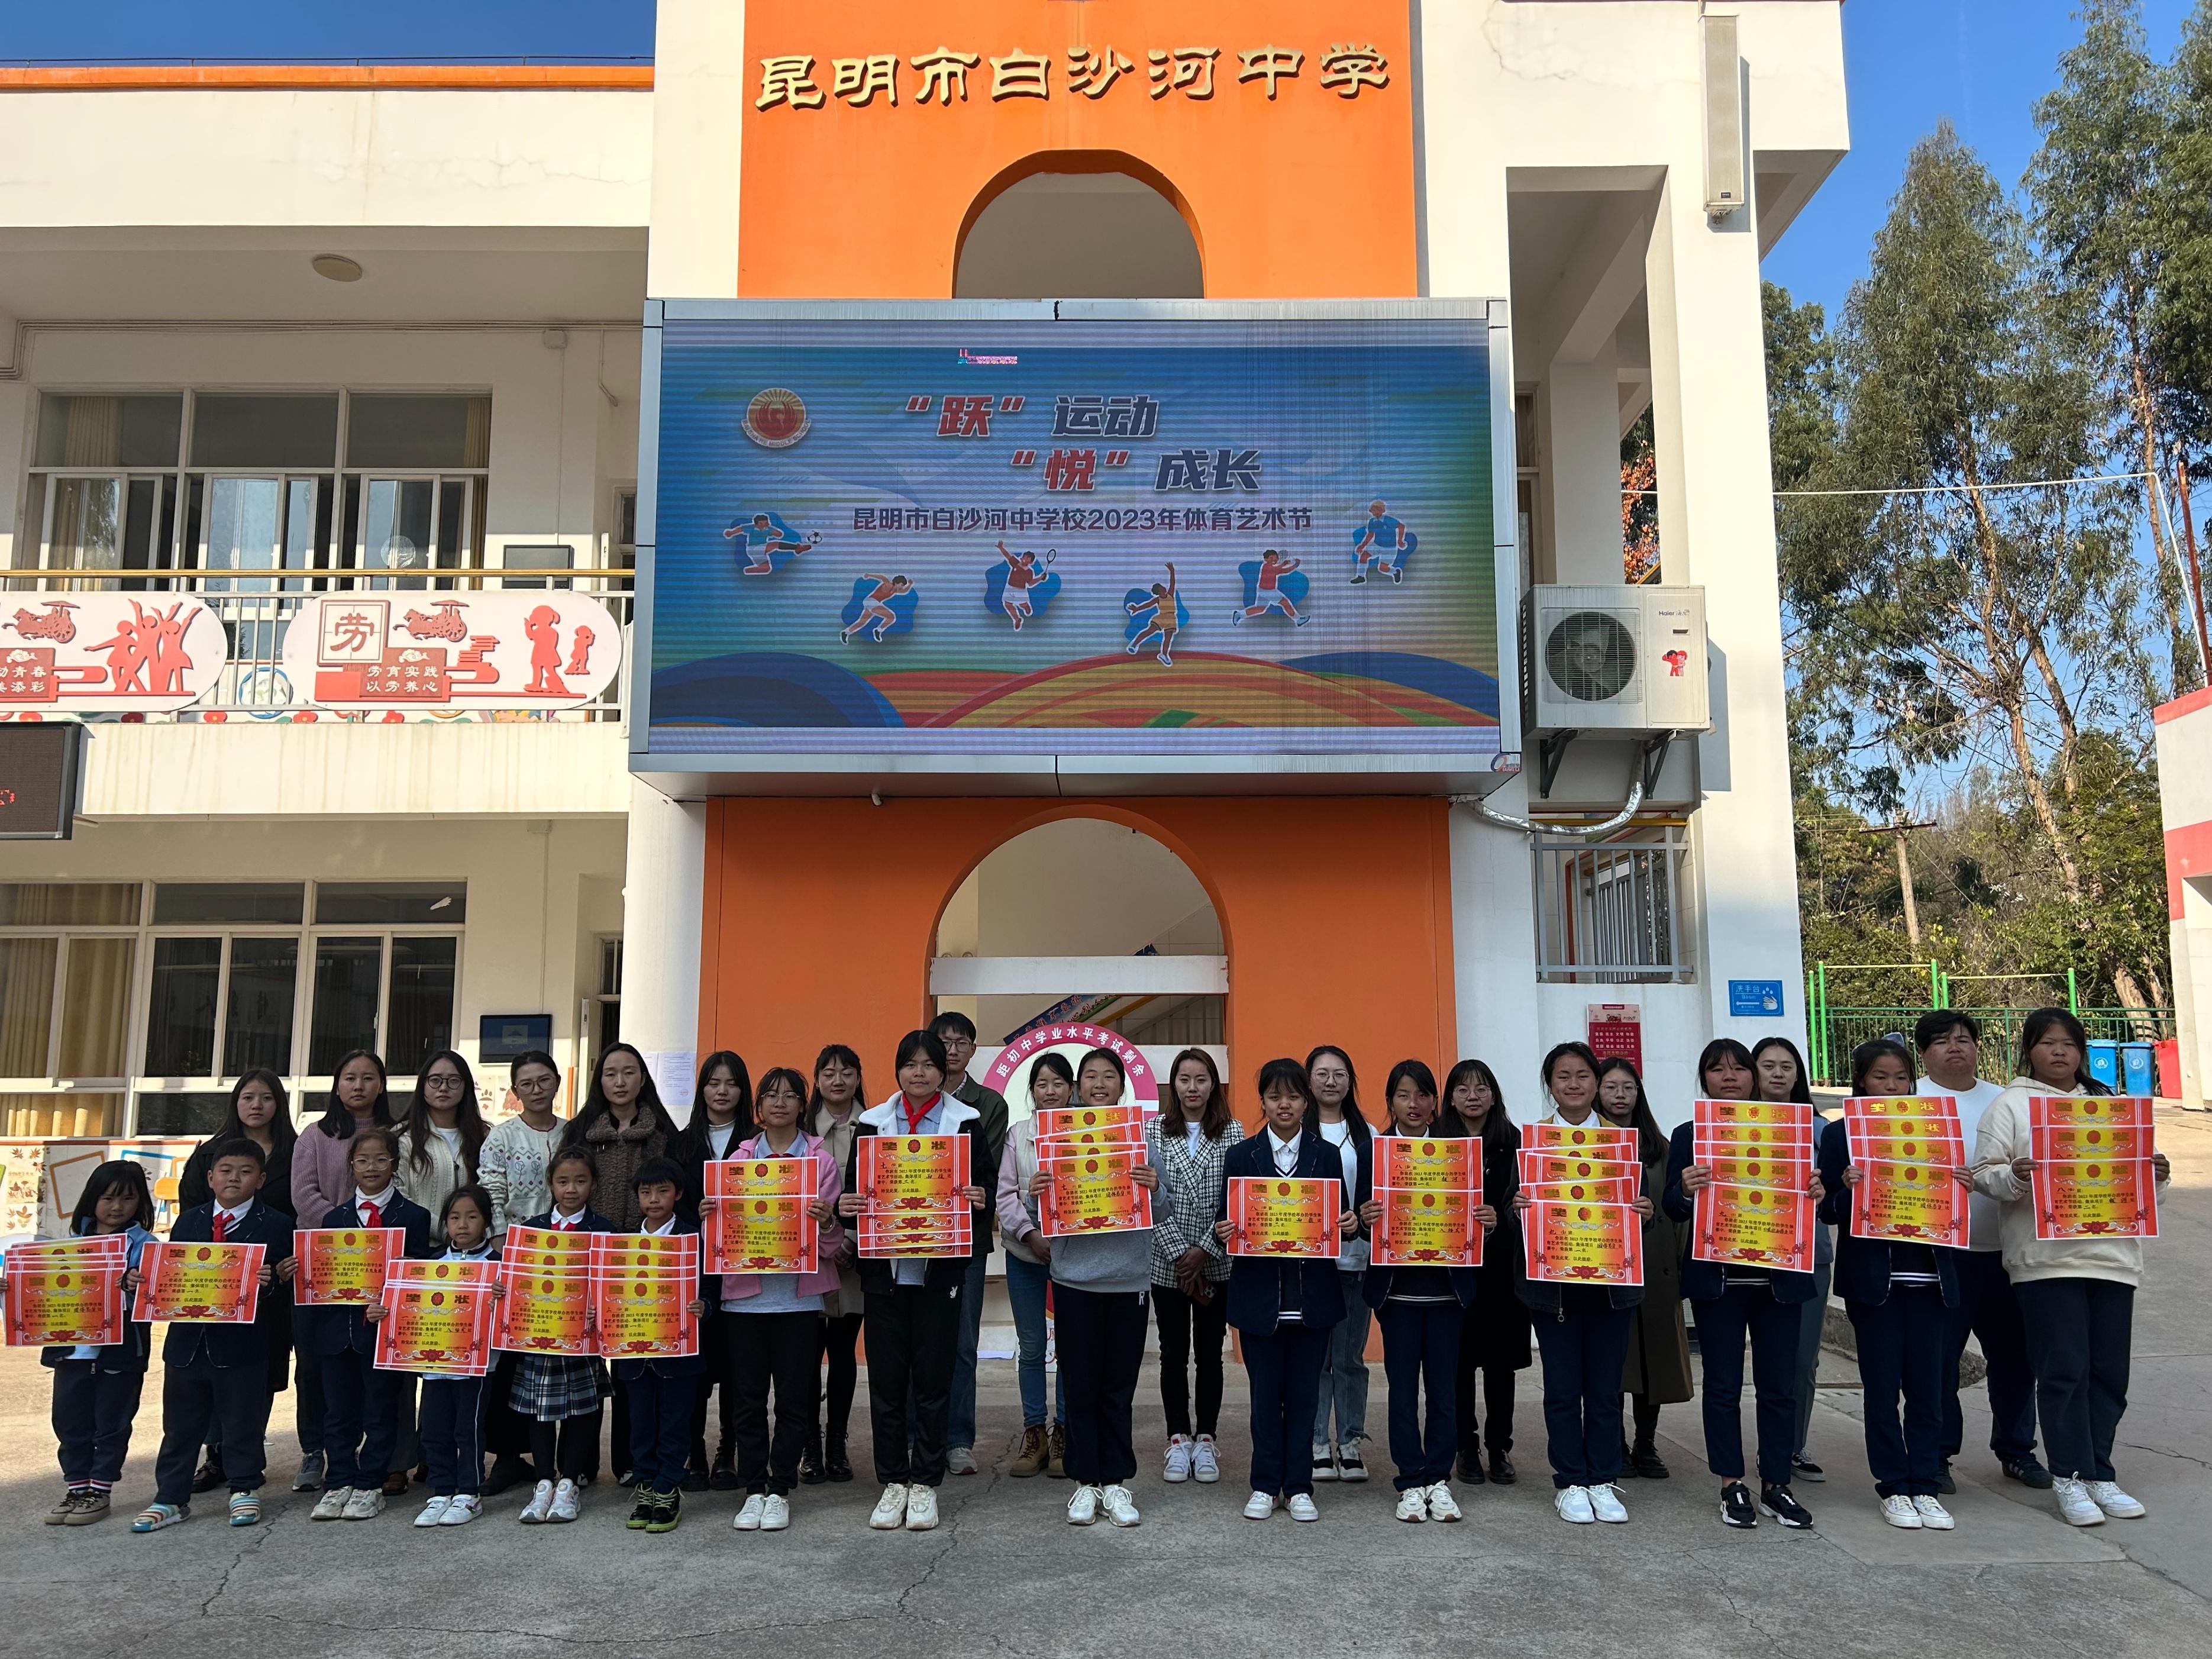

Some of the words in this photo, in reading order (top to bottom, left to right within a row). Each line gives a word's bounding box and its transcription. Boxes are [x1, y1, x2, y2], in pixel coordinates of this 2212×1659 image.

[754, 43, 1389, 110] 昆明市白沙河中学
[1051, 394, 1159, 437] 运动
[1154, 448, 1262, 491] 成长
[852, 506, 1313, 531] 昆明市白沙河中学校2023年体育艺术节
[330, 612, 374, 652] 劳
[366, 680, 438, 693] 以劳养心
[367, 665, 439, 678] 劳育实践
[1736, 985, 1760, 993] 洗手台
[996, 1025, 1145, 1078] 距初中学业水平考试剩余
[1920, 1102, 1935, 1111] 状
